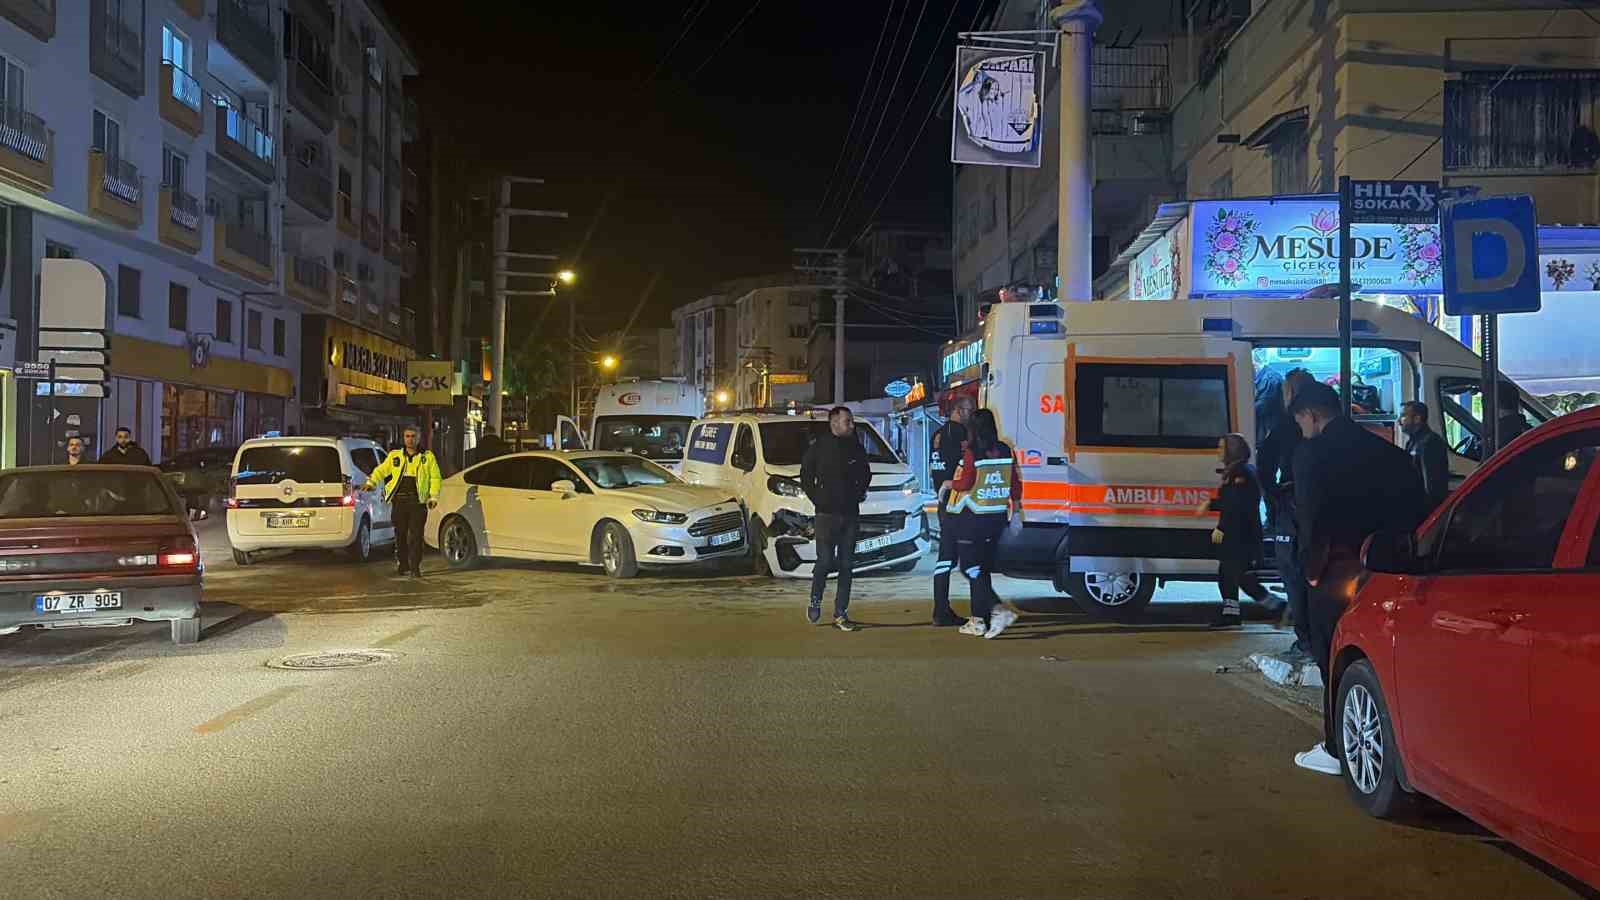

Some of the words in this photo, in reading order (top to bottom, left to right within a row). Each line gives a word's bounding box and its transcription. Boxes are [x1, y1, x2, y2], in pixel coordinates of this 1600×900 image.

[1354, 182, 1435, 198] HİLAL
[1354, 199, 1411, 210] SOKAK
[1454, 217, 1526, 293] D
[1104, 487, 1211, 505] AMBULANS
[44, 596, 61, 609] 07
[69, 595, 84, 608] ZR
[95, 593, 118, 607] 905
